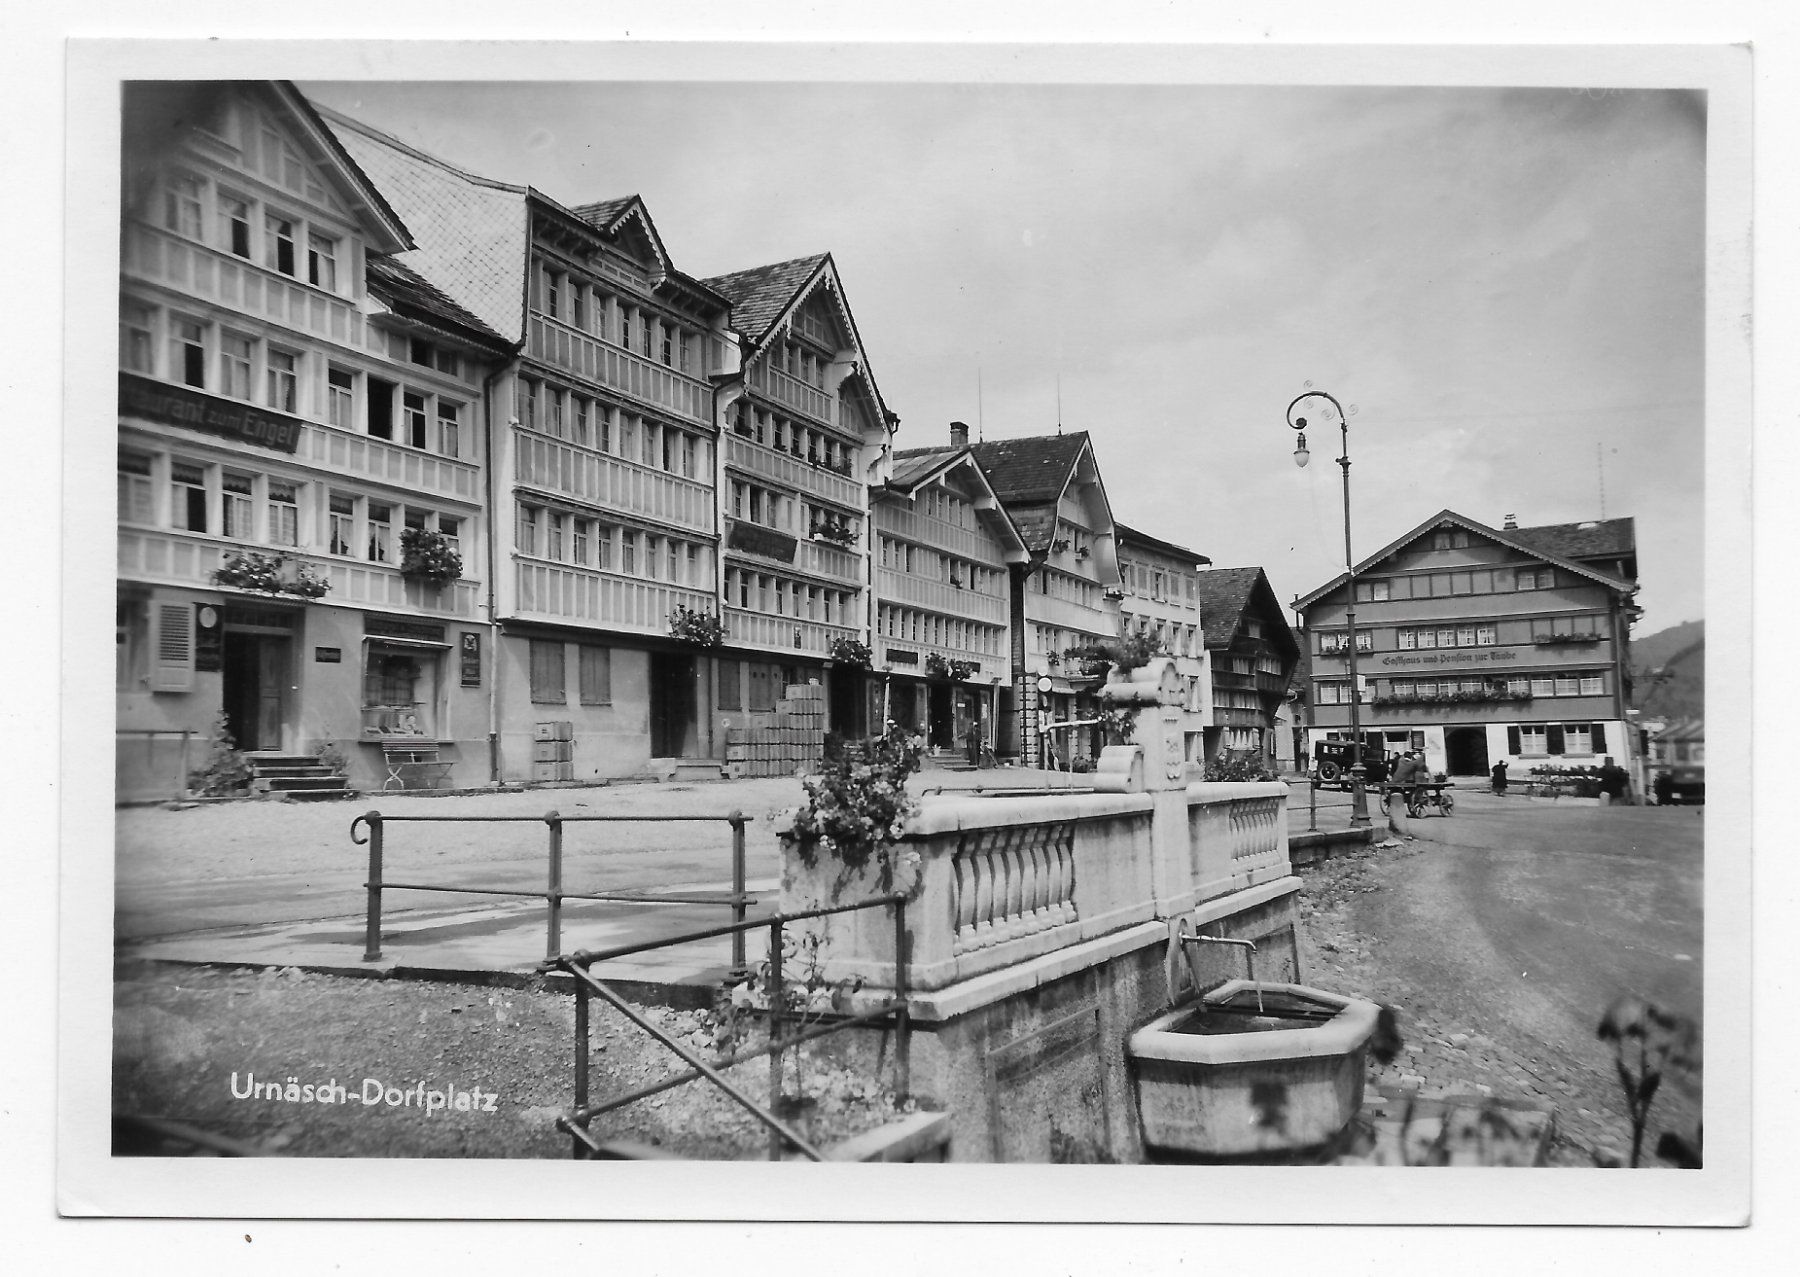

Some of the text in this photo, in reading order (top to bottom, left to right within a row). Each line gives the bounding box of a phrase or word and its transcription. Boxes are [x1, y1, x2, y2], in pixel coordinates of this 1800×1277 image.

[207, 409, 241, 430] zum
[241, 410, 294, 446] Engel
[1382, 655, 1421, 666] Gasthaus
[1423, 655, 1438, 664] und
[1440, 653, 1473, 664] Pension
[1474, 653, 1488, 664] zur
